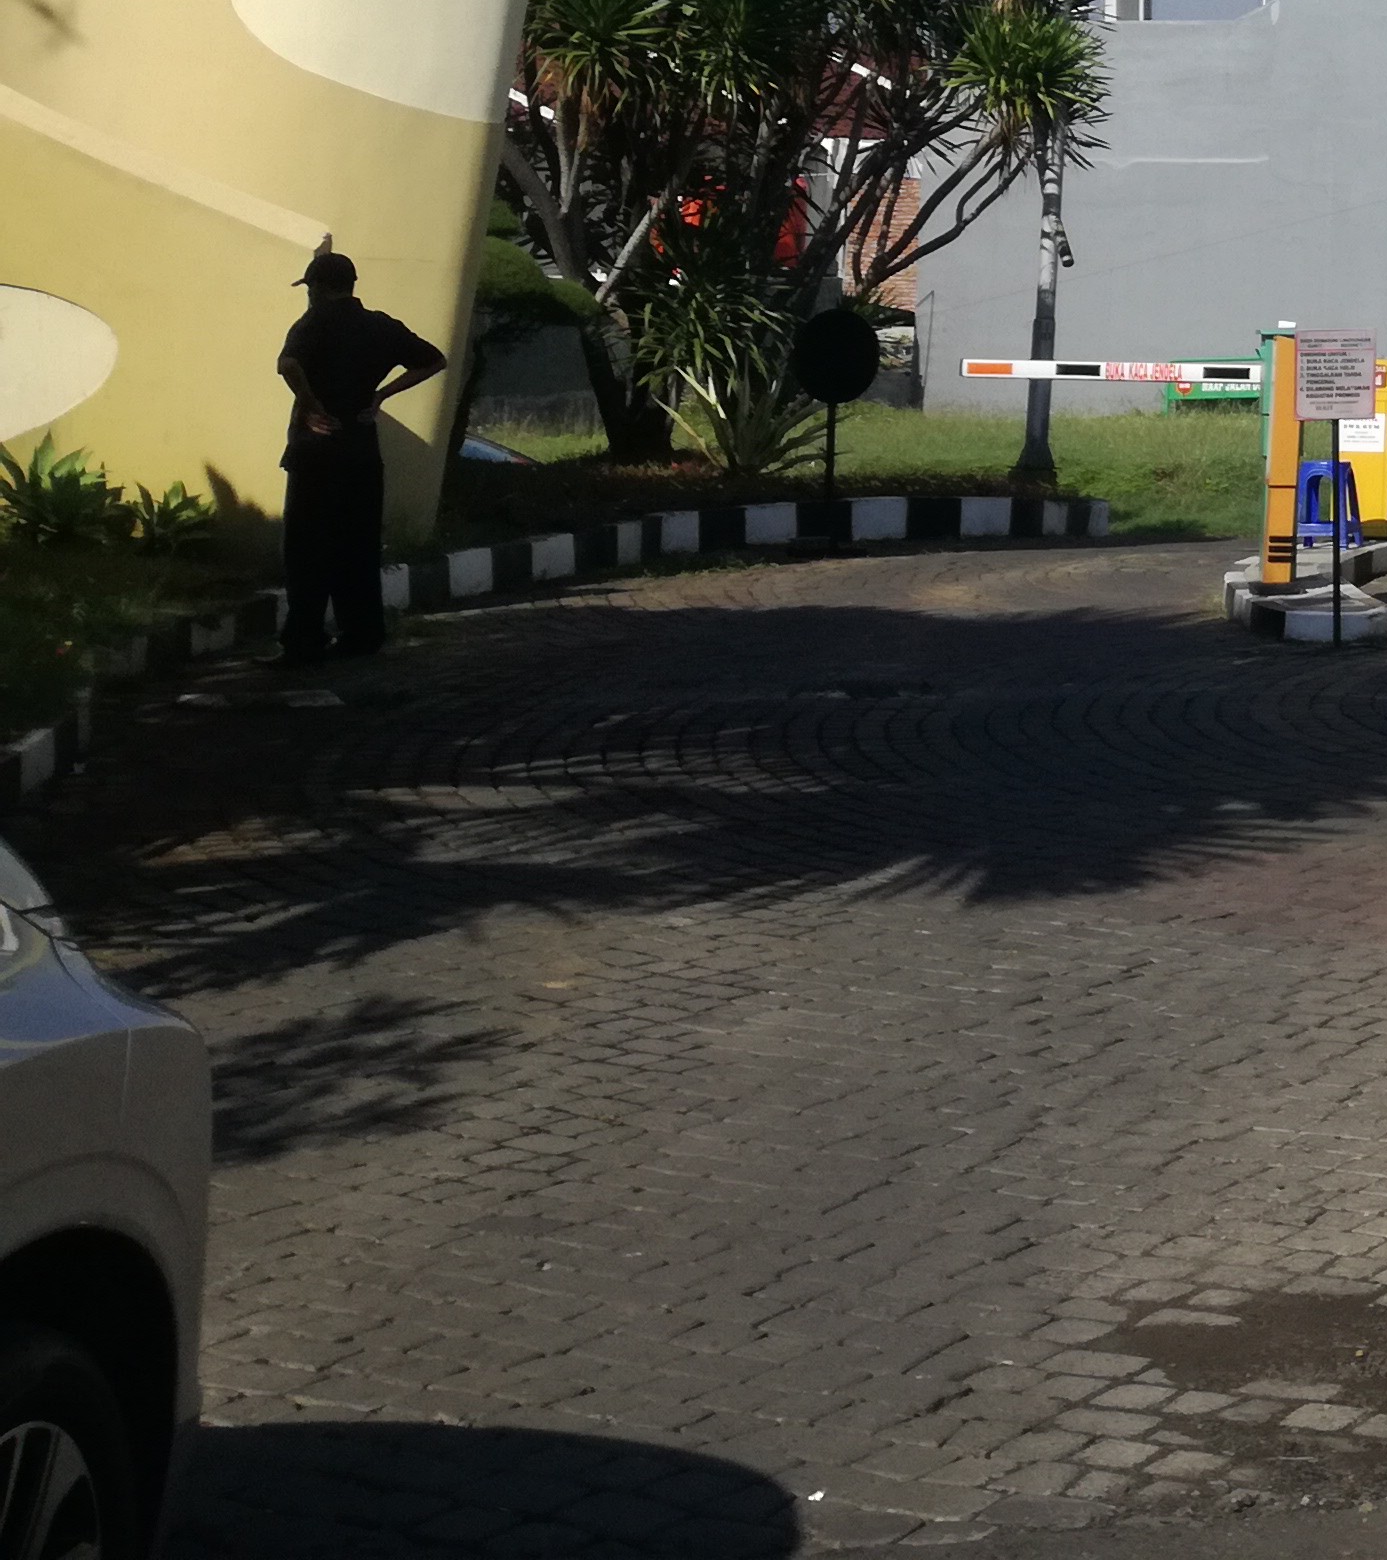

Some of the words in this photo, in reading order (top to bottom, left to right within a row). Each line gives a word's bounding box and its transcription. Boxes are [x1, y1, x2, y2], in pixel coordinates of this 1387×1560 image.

[1105, 362, 1124, 380] BUKA
[1128, 362, 1148, 380] KACA
[1150, 362, 1182, 380] JENDELA
